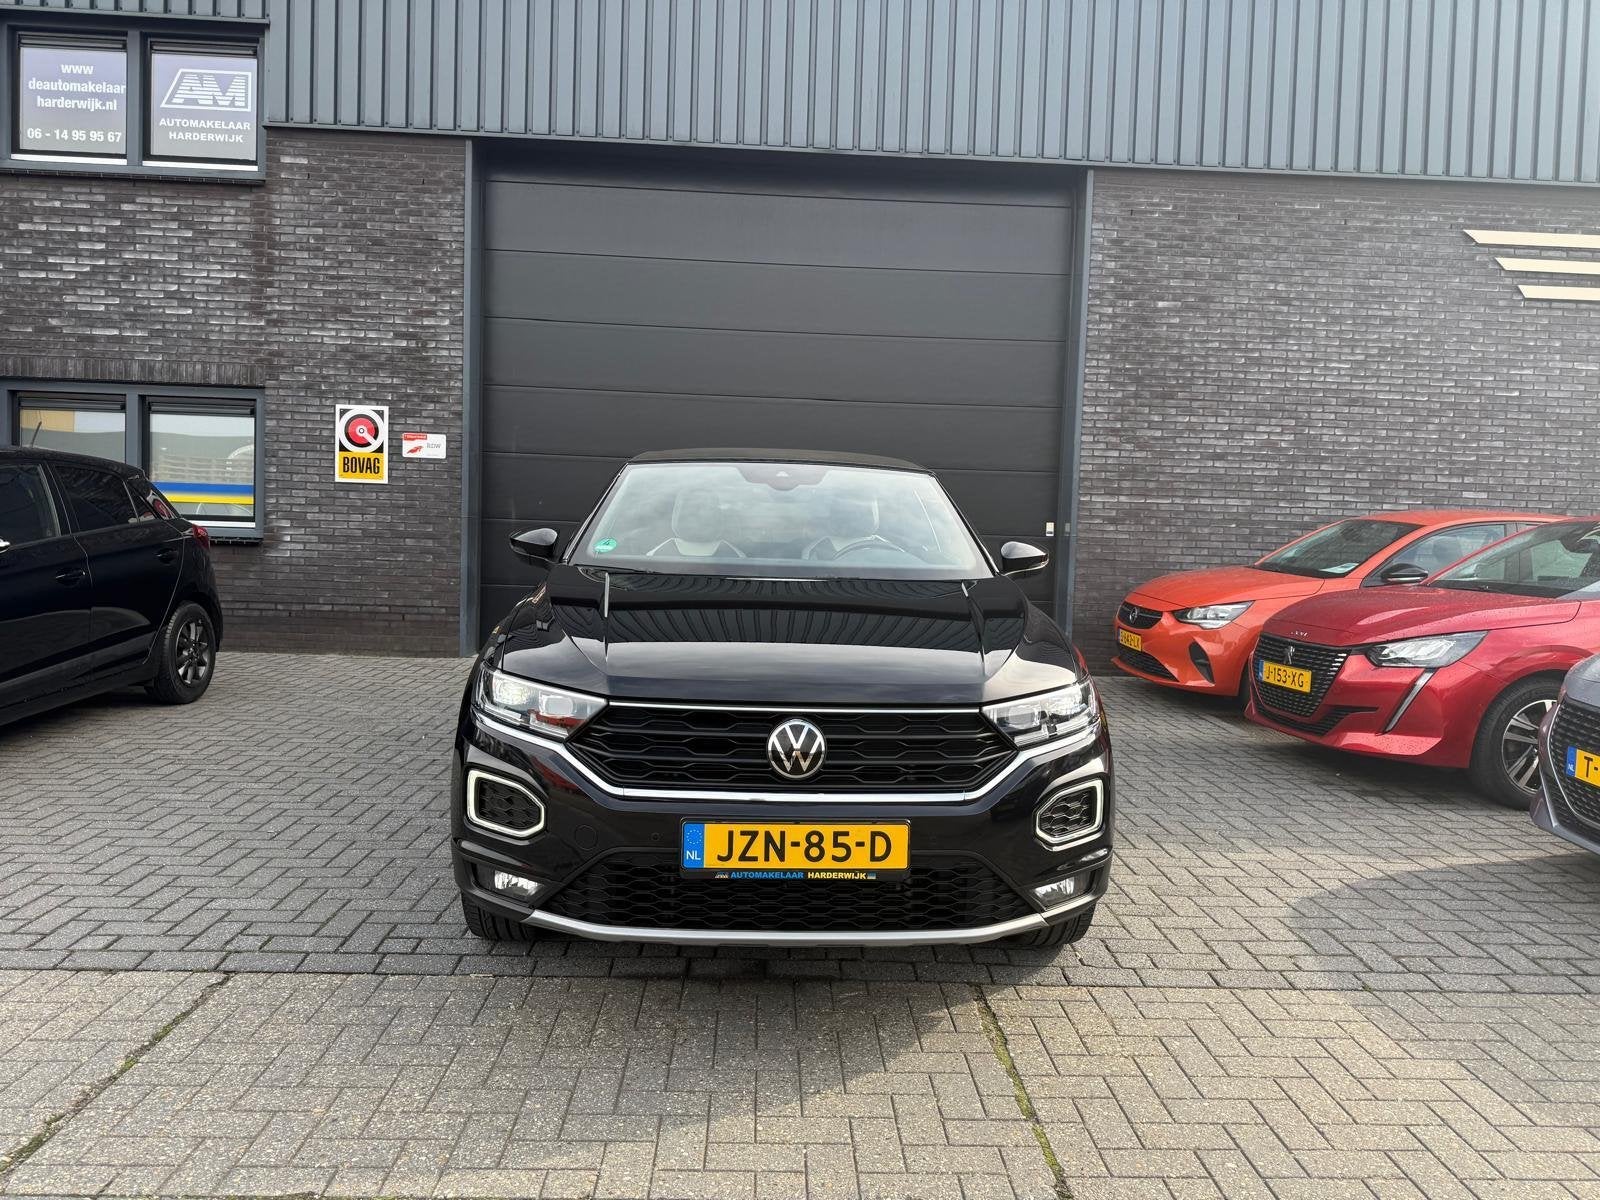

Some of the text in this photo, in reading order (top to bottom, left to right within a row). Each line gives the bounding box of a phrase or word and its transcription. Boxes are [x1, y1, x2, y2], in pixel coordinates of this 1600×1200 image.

[61, 64, 94, 75] www
[28, 78, 126, 94] deautomakelaar
[37, 95, 118, 112] harderwijk.nl
[159, 118, 250, 130] AUTOMAKELAAR
[27, 128, 42, 139] 06
[54, 129, 69, 141] 14
[71, 130, 87, 141] 95
[90, 131, 104, 142] 95
[107, 132, 122, 143] 67
[169, 131, 243, 143] HARDERWIJK
[343, 456, 380, 474] BOVAG
[1266, 666, 1304, 688] J-153-XG
[686, 830, 892, 863] NL JZN-85-D
[730, 871, 804, 880] AUTOMAKELAAR
[807, 871, 867, 880] HARDERWIJK
